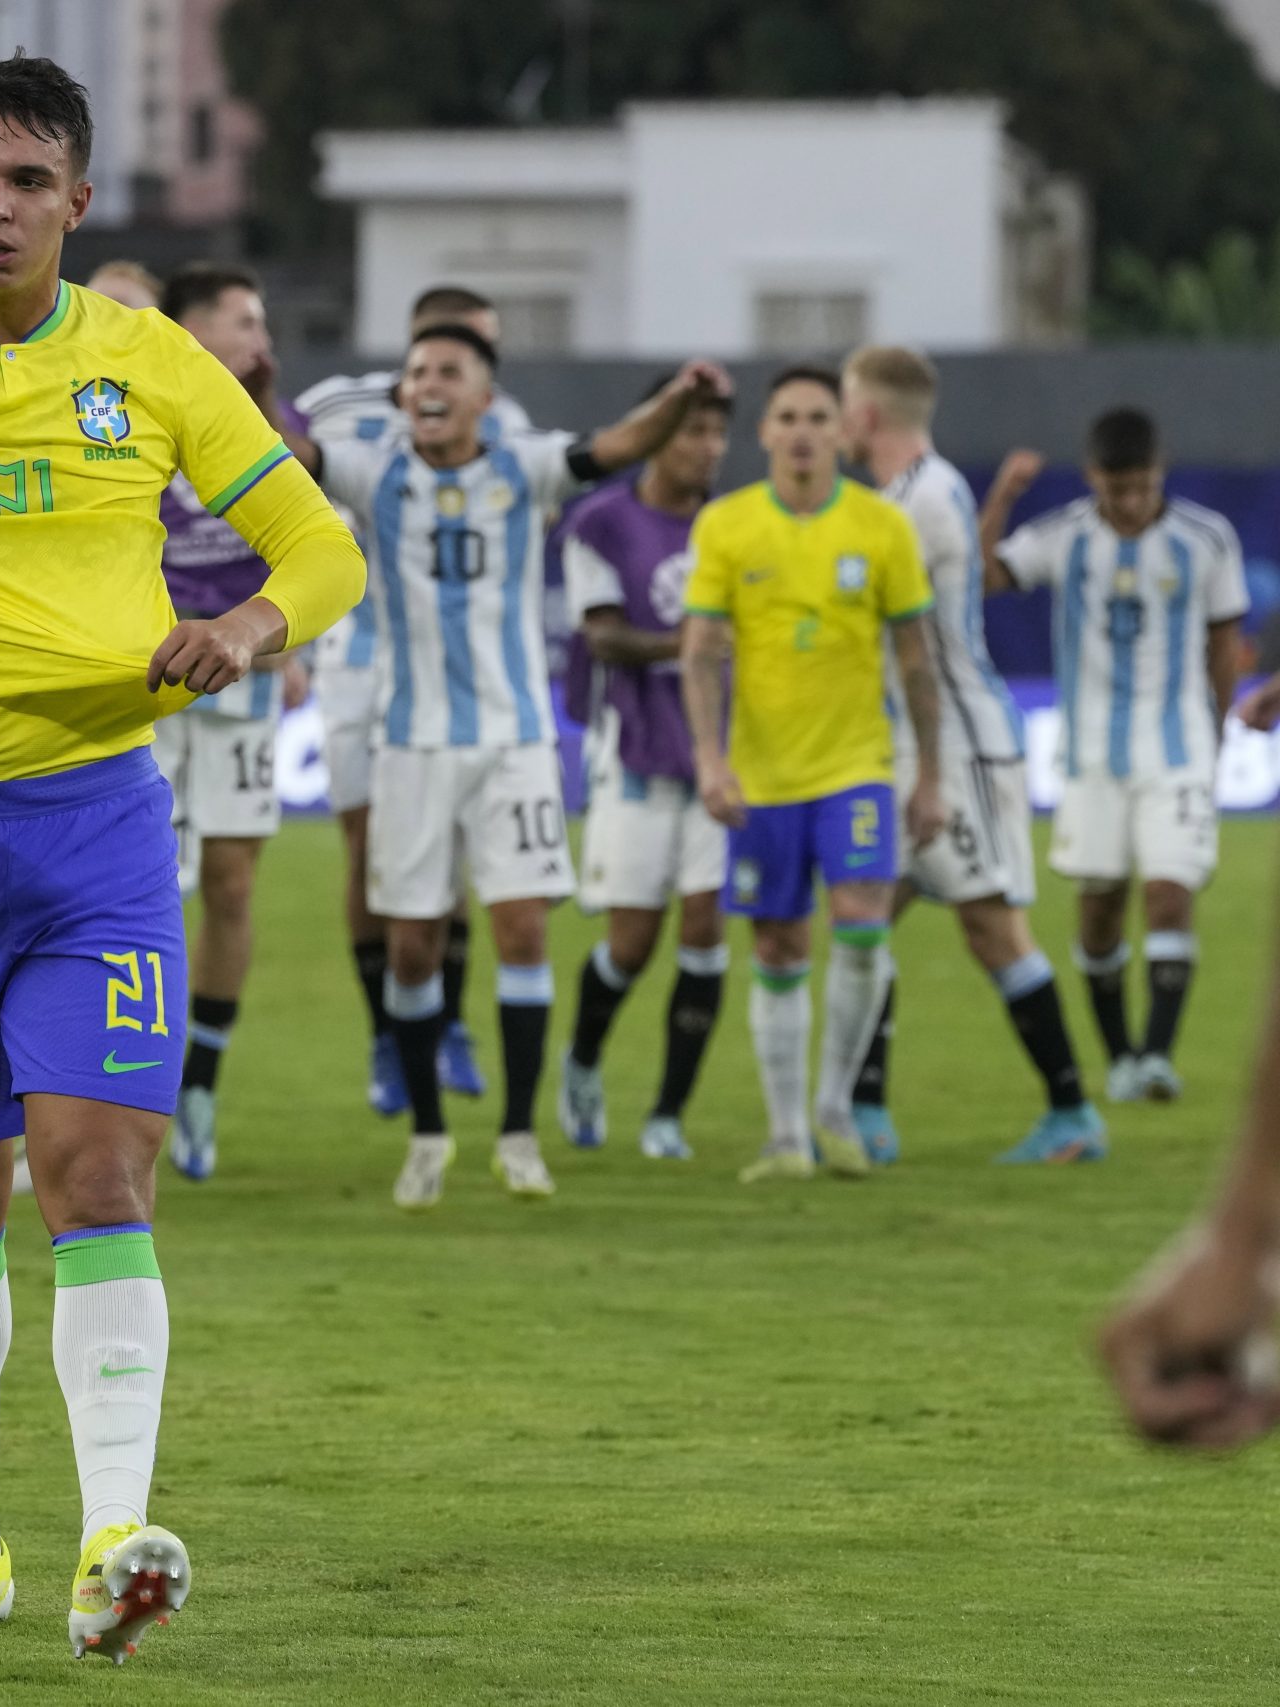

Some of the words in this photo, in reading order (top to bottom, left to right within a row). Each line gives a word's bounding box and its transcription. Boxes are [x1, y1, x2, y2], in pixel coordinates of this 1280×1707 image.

[91, 407, 111, 416] CBF
[83, 446, 140, 461] BRASIL
[428, 526, 486, 582] 10
[511, 797, 563, 853] 10
[850, 798, 880, 848] 2
[101, 950, 169, 1038] 21
